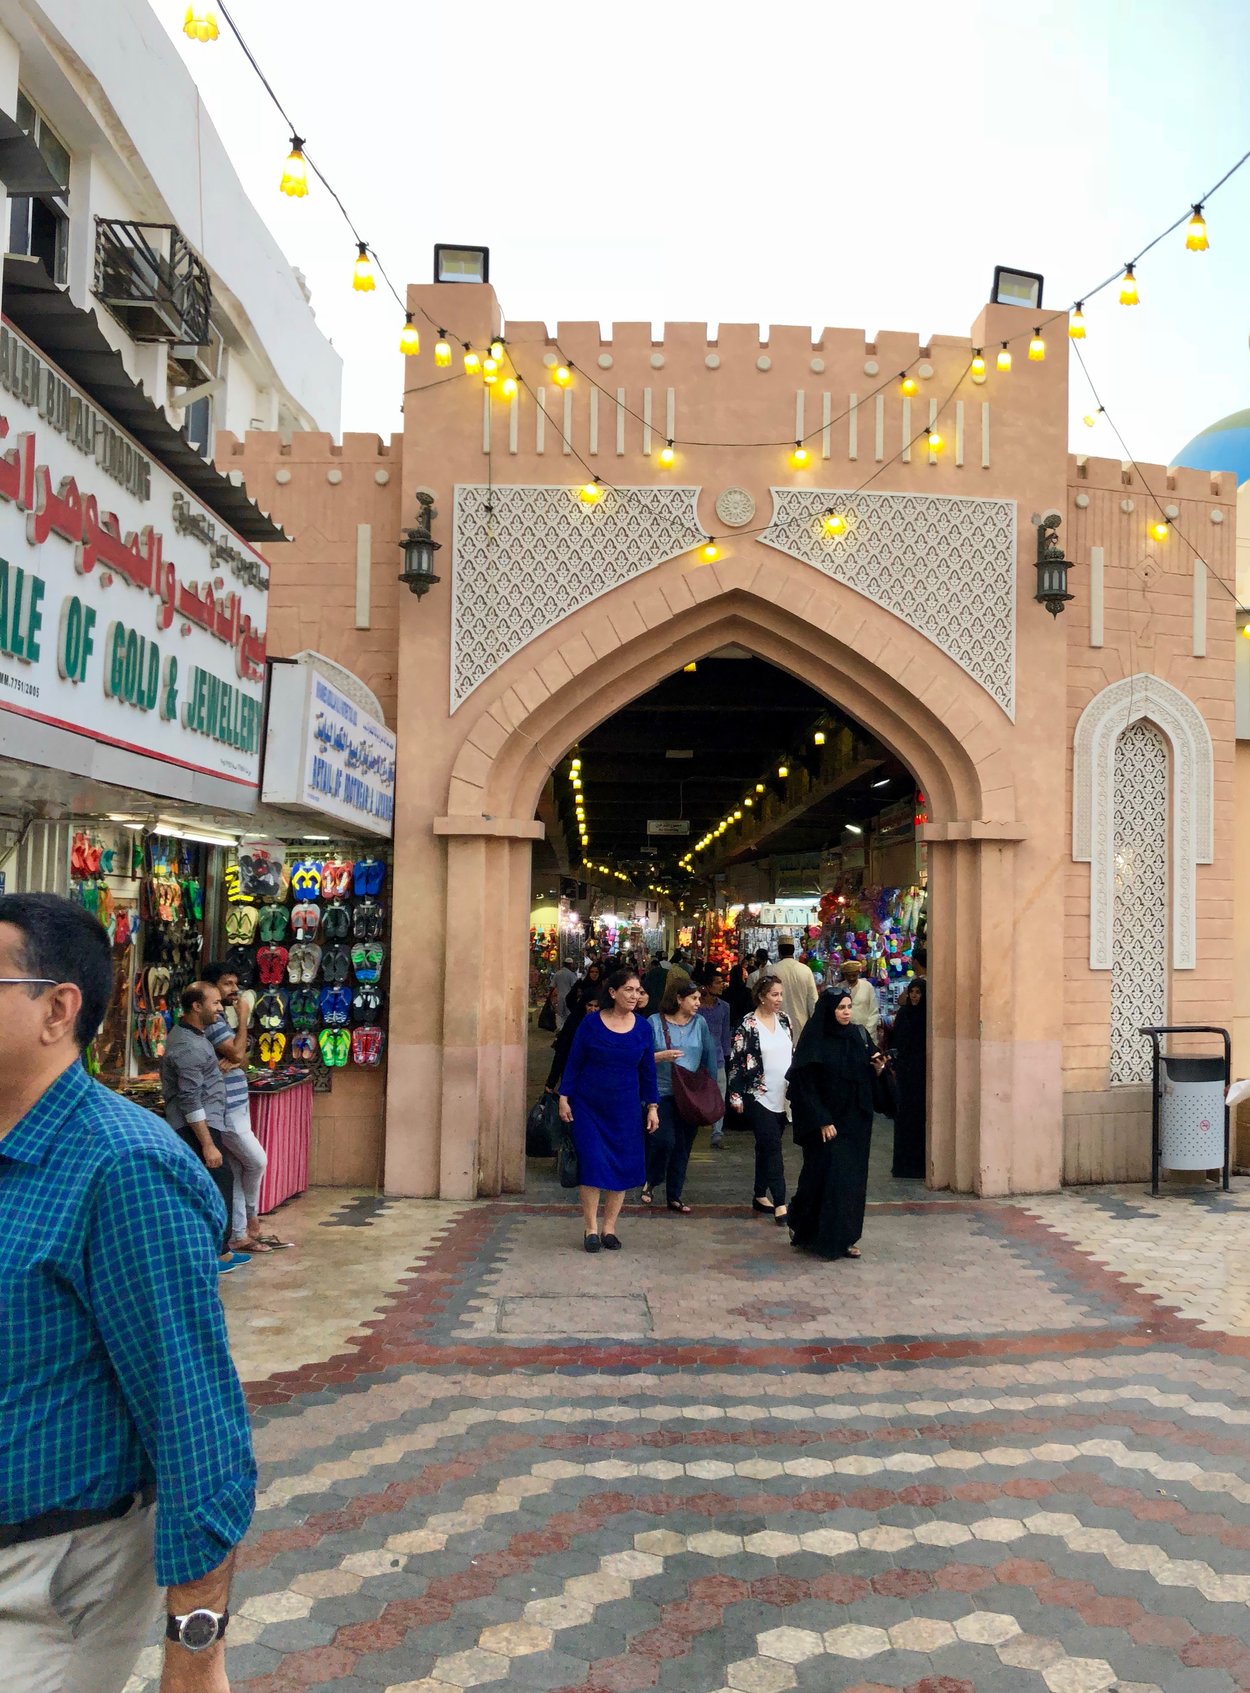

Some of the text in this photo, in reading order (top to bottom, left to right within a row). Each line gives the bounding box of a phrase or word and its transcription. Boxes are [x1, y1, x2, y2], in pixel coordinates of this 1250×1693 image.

[174, 576, 241, 648] الذهب
[57, 594, 97, 685] OF
[104, 619, 160, 712] GOLD
[160, 654, 178, 721] &
[181, 664, 263, 757] JEWELLERY
